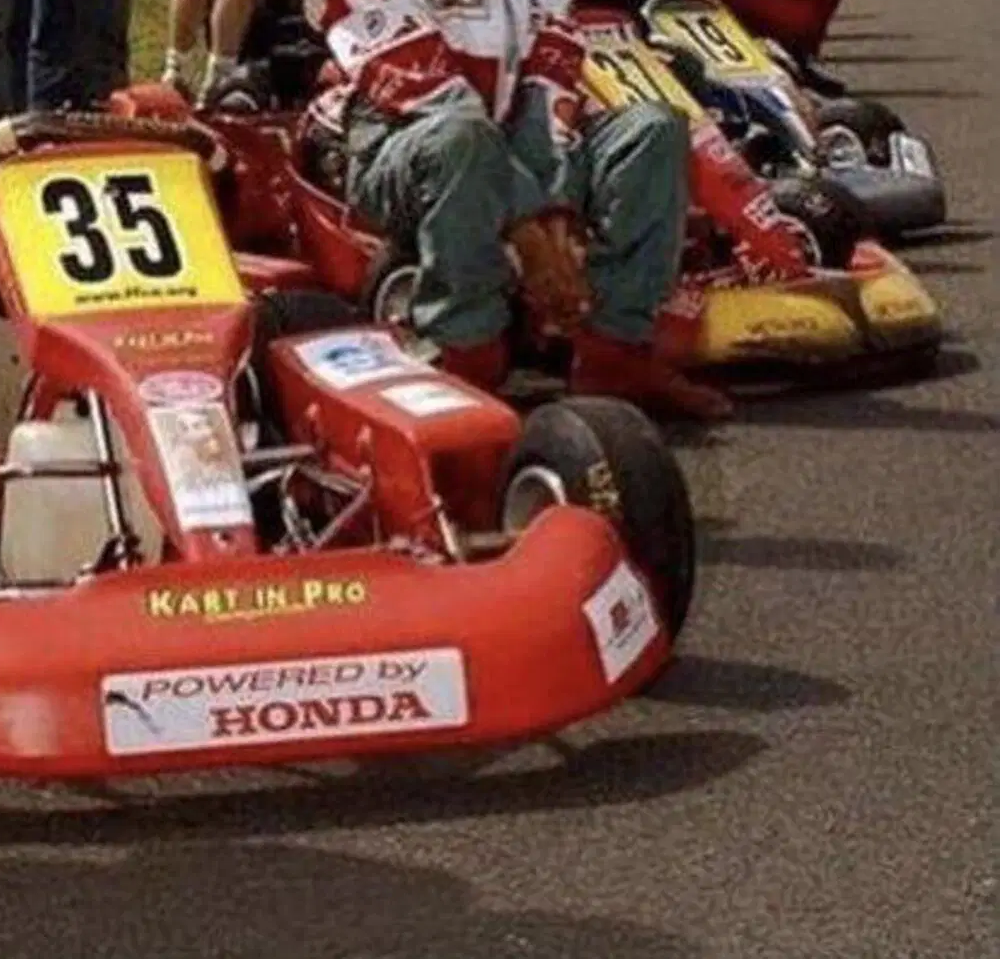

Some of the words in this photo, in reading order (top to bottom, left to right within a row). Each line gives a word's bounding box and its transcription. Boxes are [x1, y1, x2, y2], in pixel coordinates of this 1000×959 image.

[675, 13, 746, 64] 19
[41, 174, 182, 283] 35
[149, 588, 240, 617] KART
[256, 585, 287, 610] IN
[303, 579, 366, 608] PRO
[141, 663, 366, 700] POWERED
[377, 659, 428, 682] by
[209, 691, 431, 739] HONDA
